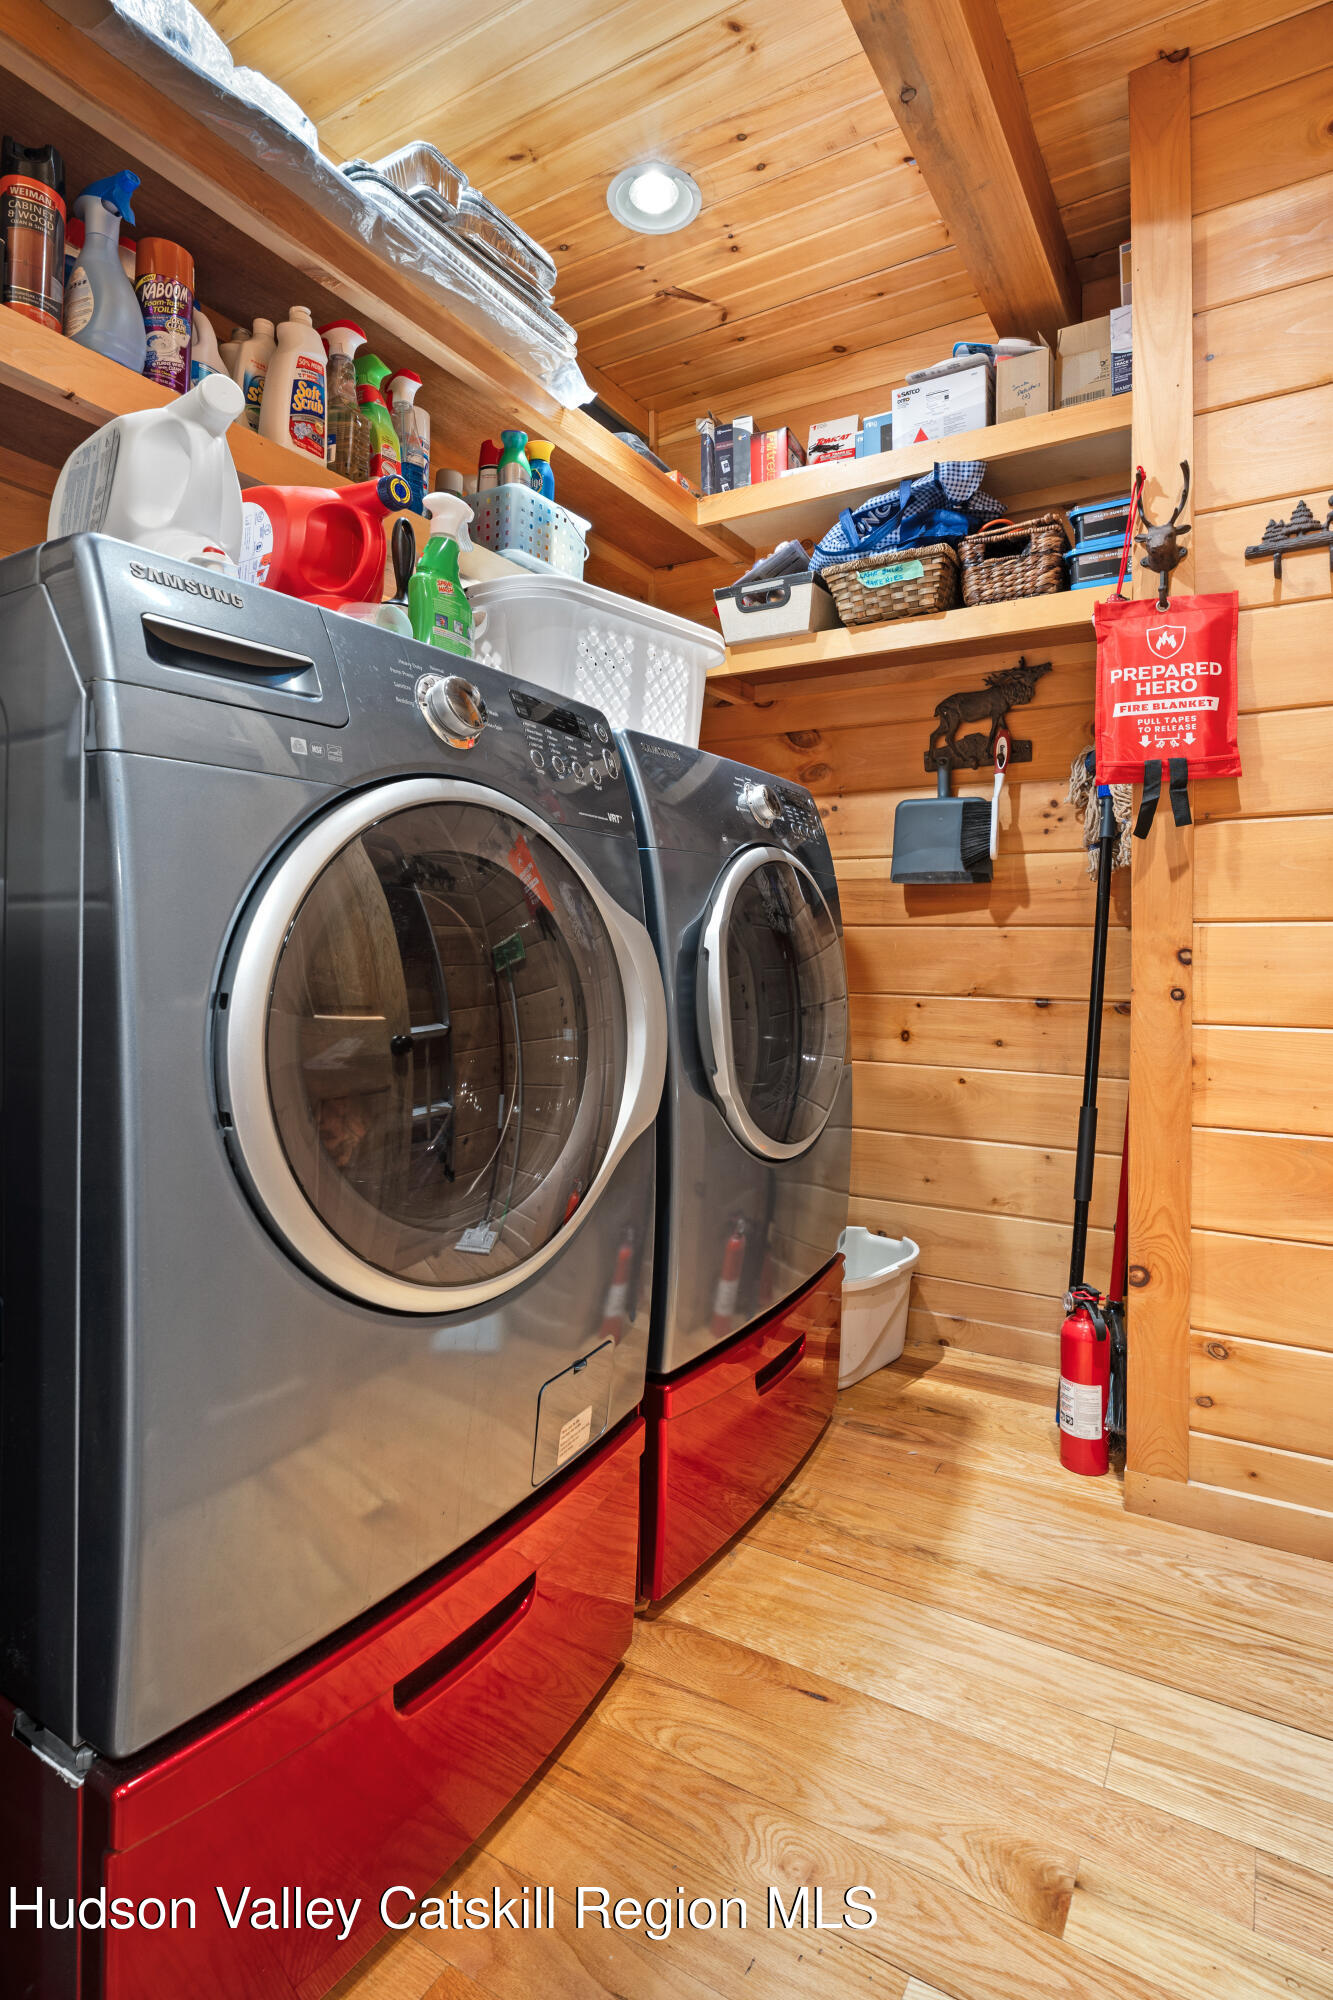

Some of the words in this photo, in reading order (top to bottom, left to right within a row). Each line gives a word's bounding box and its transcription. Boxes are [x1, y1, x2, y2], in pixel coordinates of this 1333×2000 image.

[10, 186, 52, 207] WEIMAN
[8, 200, 54, 221] CABINET
[18, 211, 54, 231] WOOD
[142, 282, 188, 303] KABOOM
[297, 380, 320, 400] Soft
[292, 394, 324, 414] Scrub
[817, 432, 852, 446] TOMCAT
[130, 561, 244, 608] SAMSUNG
[1110, 662, 1222, 684] PREPARED
[1136, 678, 1197, 696] HERO
[1120, 704, 1149, 713] FIRE
[1152, 699, 1214, 710] BLANKET
[1137, 717, 1161, 725] PULL
[1164, 715, 1197, 724] TAPES
[1154, 723, 1197, 732] RELEASE
